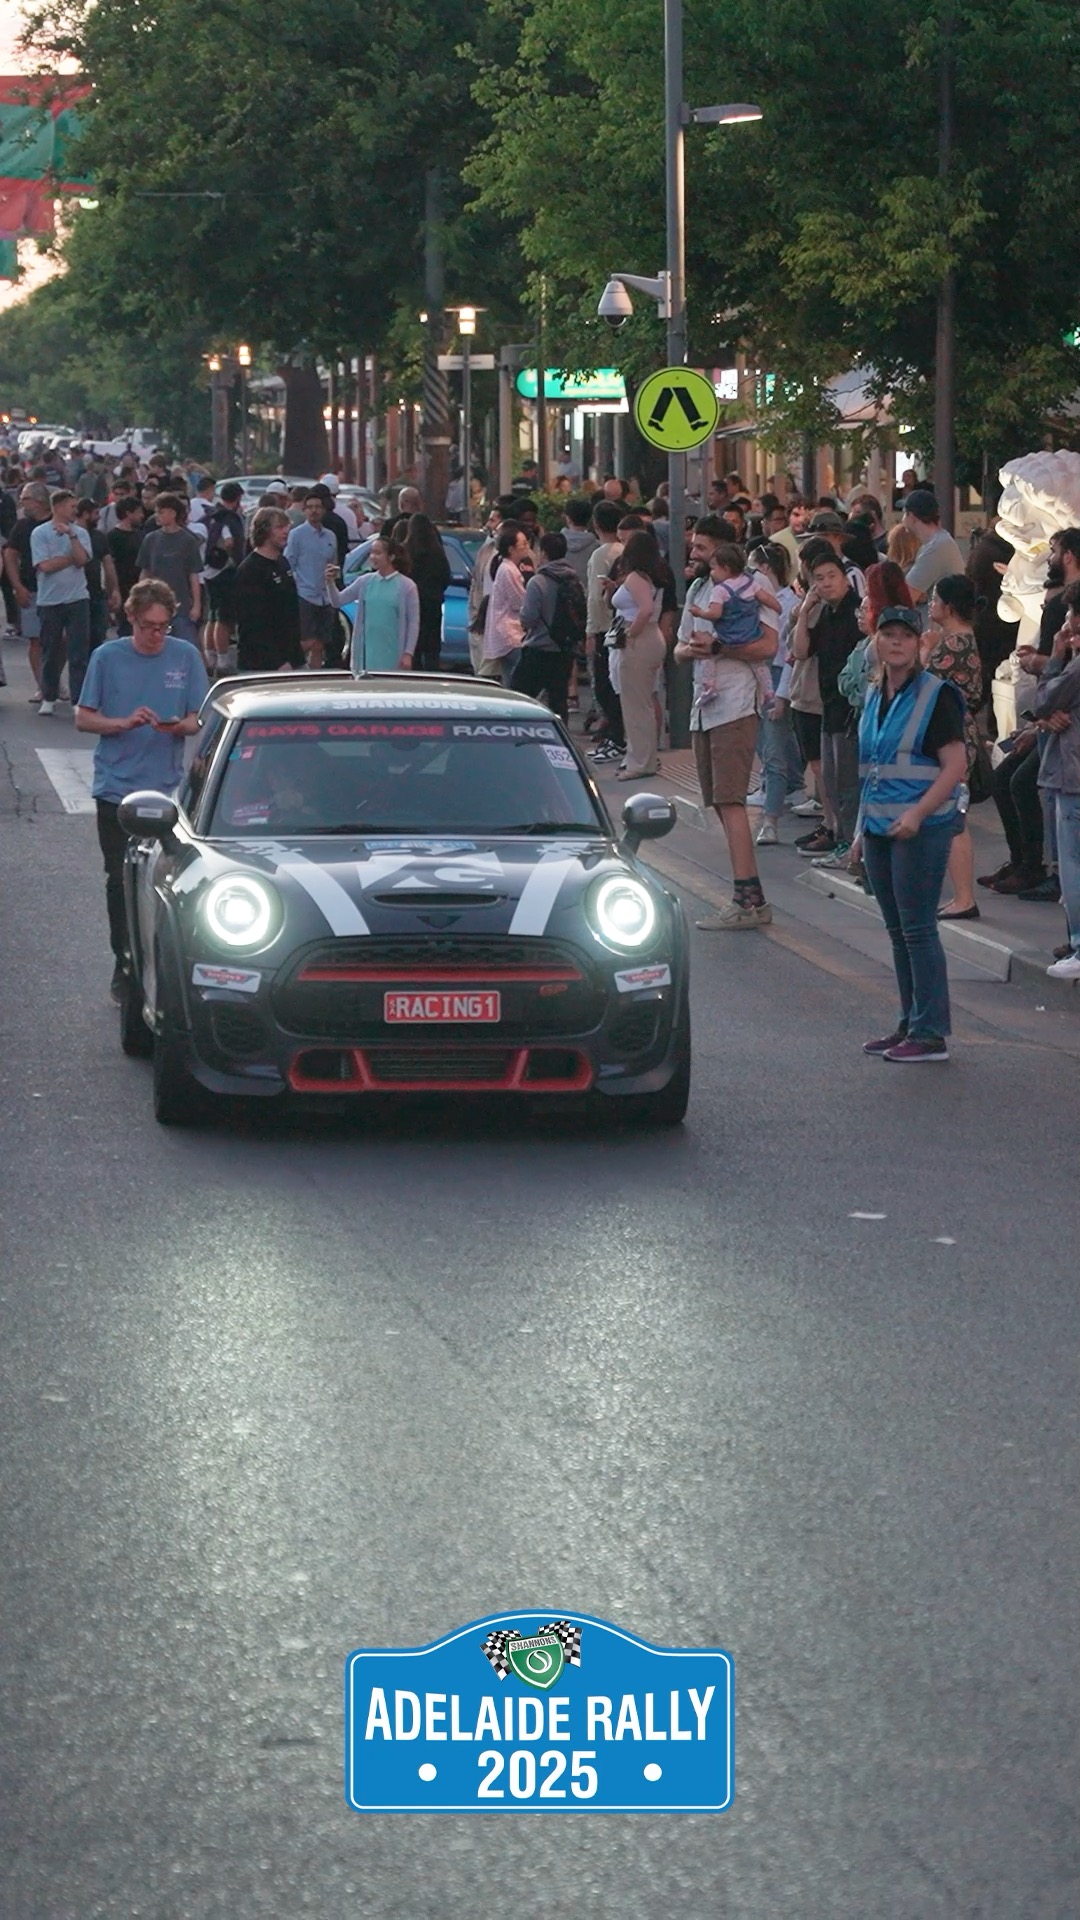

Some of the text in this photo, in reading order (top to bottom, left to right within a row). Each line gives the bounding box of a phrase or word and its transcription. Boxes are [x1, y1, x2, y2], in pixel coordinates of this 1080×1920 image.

[331, 699, 477, 711] SHANNONS
[327, 724, 444, 738] GARAGE
[453, 725, 555, 739] RACING
[546, 749, 574, 762] 352
[396, 996, 494, 1018] RACING1
